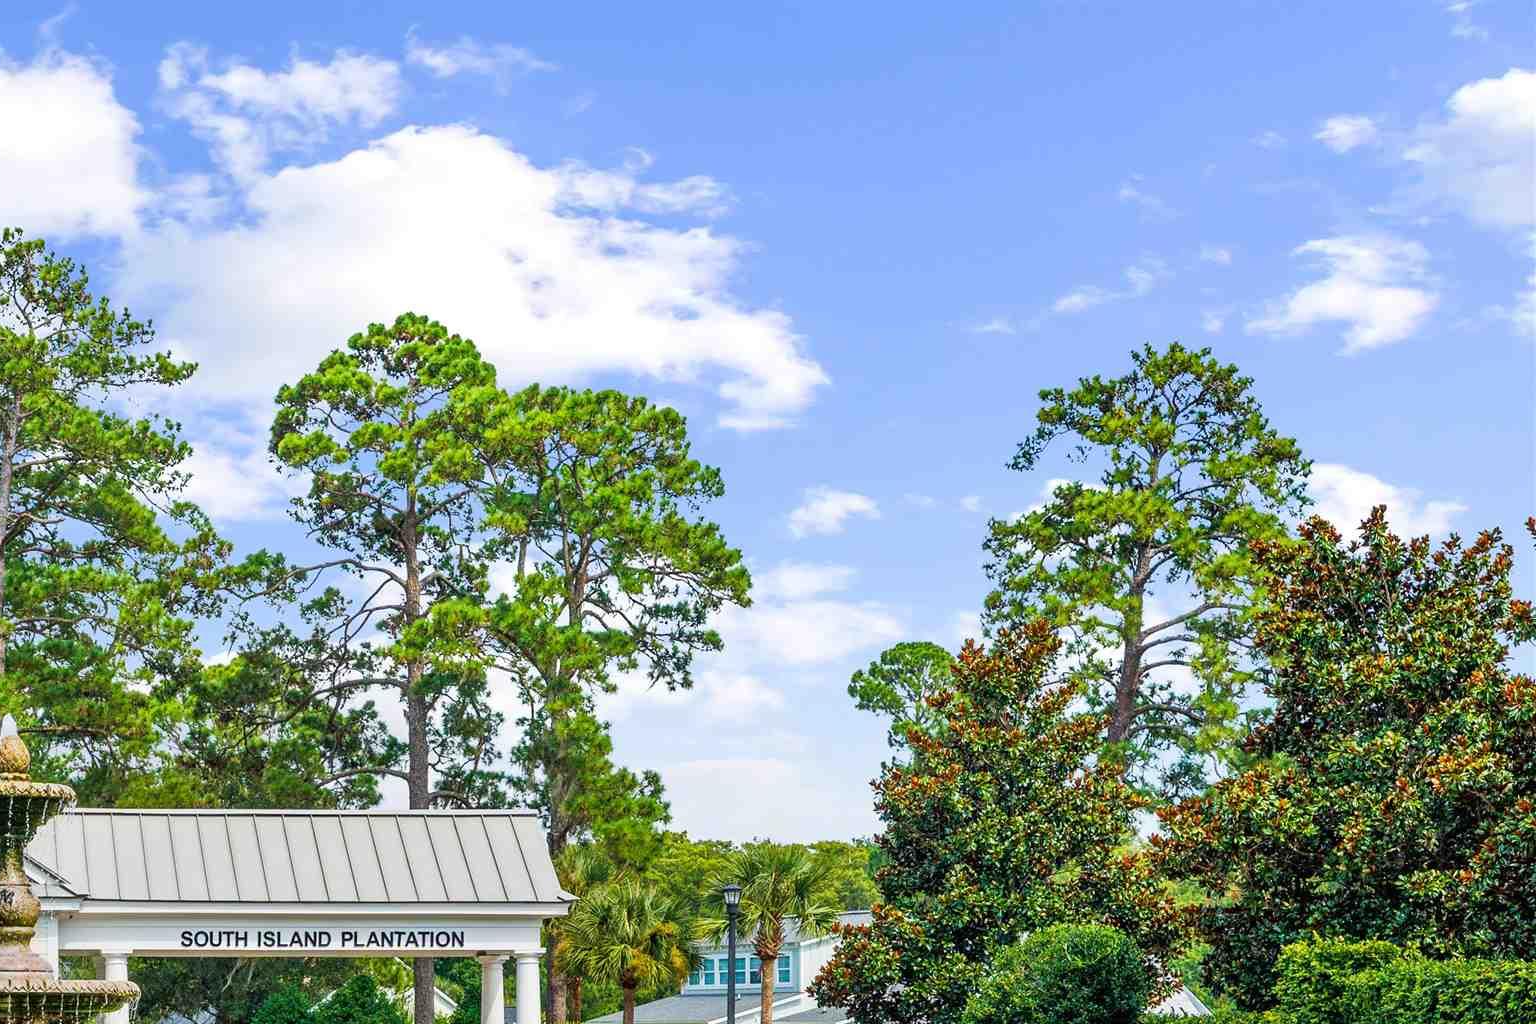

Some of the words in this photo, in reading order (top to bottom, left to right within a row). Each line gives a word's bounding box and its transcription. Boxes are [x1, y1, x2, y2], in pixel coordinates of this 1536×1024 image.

[180, 931, 248, 947] SOUTH
[257, 931, 332, 947] ISLAND
[341, 931, 465, 948] PLANTATION
